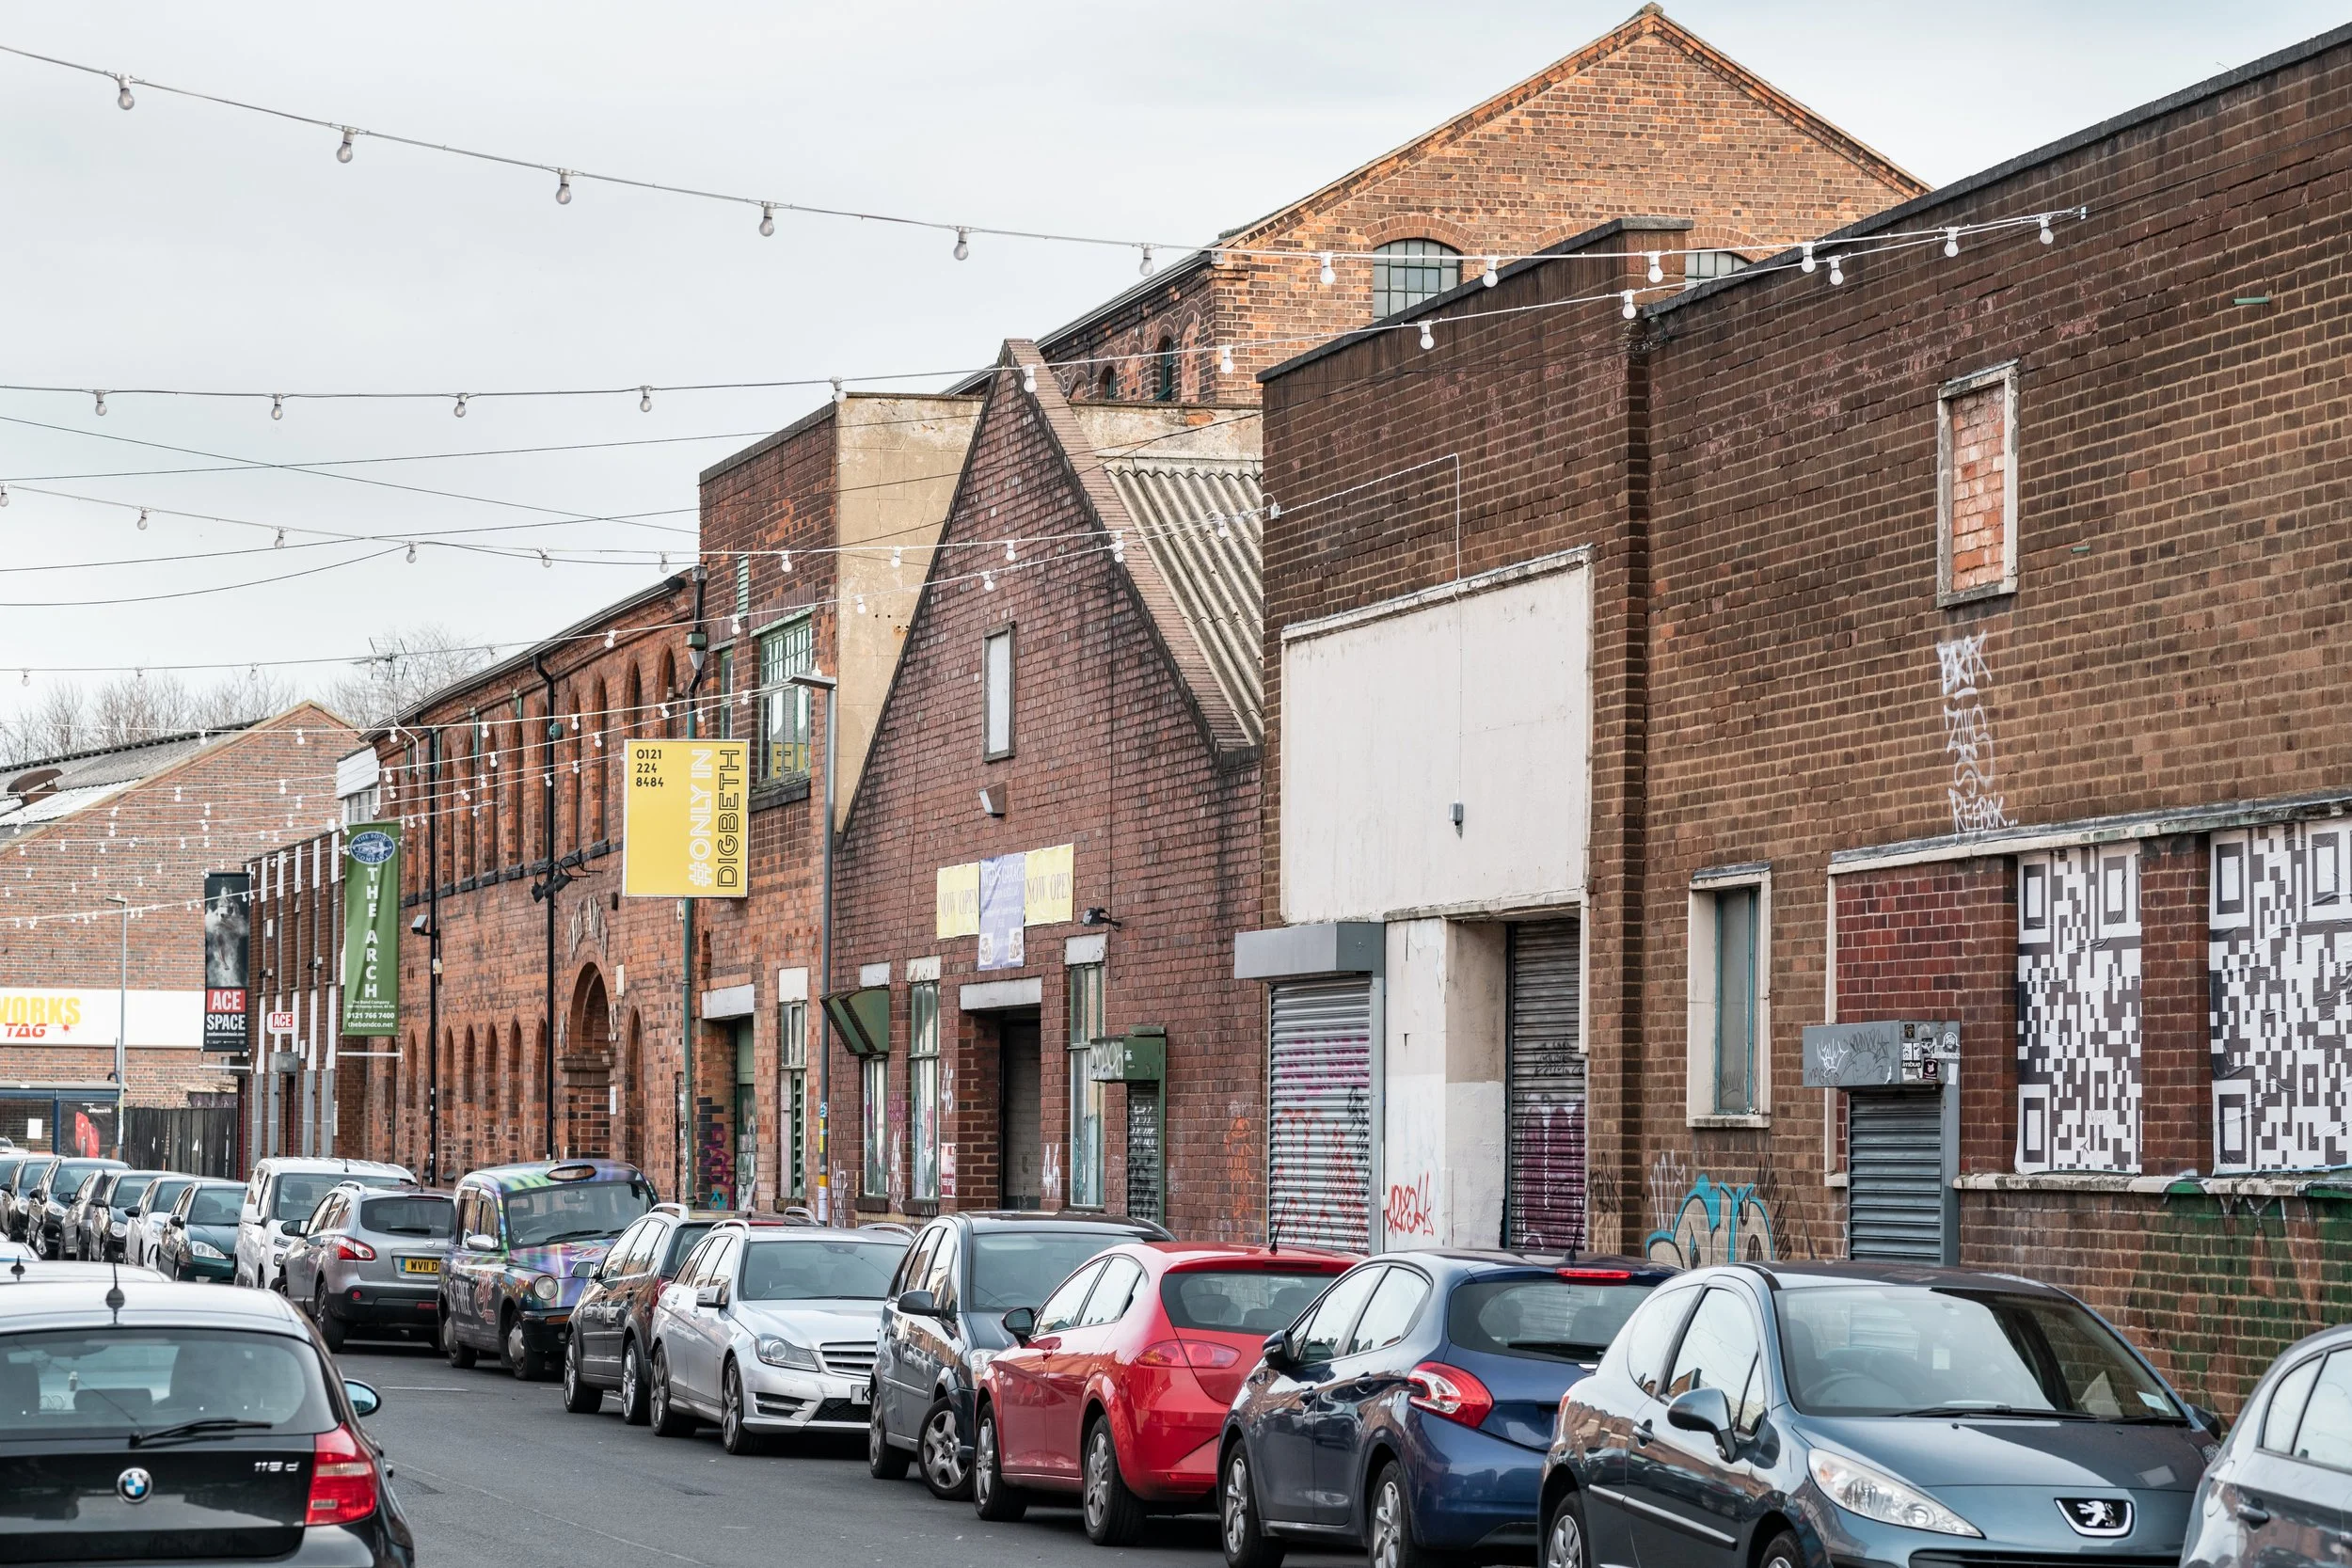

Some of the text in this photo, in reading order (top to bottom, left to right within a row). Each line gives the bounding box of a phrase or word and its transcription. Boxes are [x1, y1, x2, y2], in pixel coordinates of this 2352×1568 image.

[636, 749, 662, 760] 0121
[636, 763, 658, 773] 224
[635, 776, 664, 787] 8484
[689, 749, 712, 887] #ONLY IN
[717, 750, 740, 887] DIGBETH
[1026, 876, 1045, 905] NOW
[1049, 871, 1072, 901] OPEN
[959, 887, 978, 915] OPEN
[364, 867, 378, 998] THE ARCH
[212, 990, 242, 1011] ACE
[5, 1022, 48, 1038] TAG
[207, 1014, 246, 1031] SPACE
[274, 1014, 293, 1027] ACE
